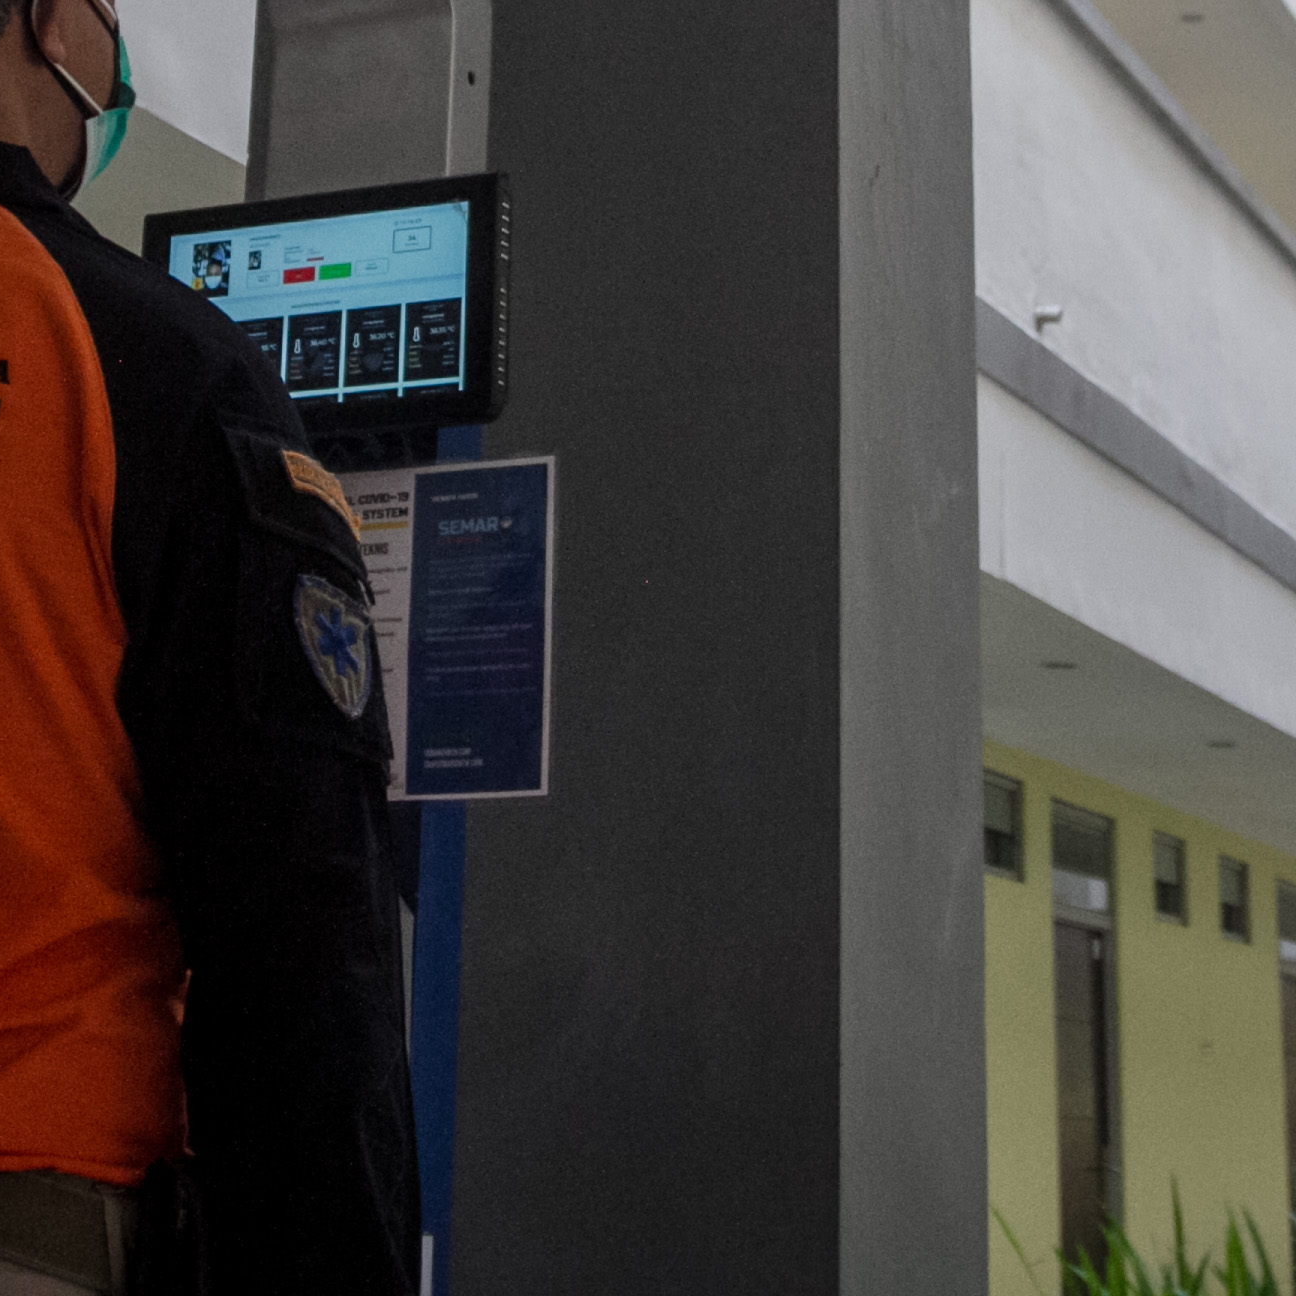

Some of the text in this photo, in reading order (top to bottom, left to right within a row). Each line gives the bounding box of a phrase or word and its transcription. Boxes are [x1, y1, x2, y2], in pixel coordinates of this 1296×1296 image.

[358, 491, 409, 505] COVID-19
[363, 507, 409, 520] SYSTEM
[439, 516, 498, 536] SEMAR
